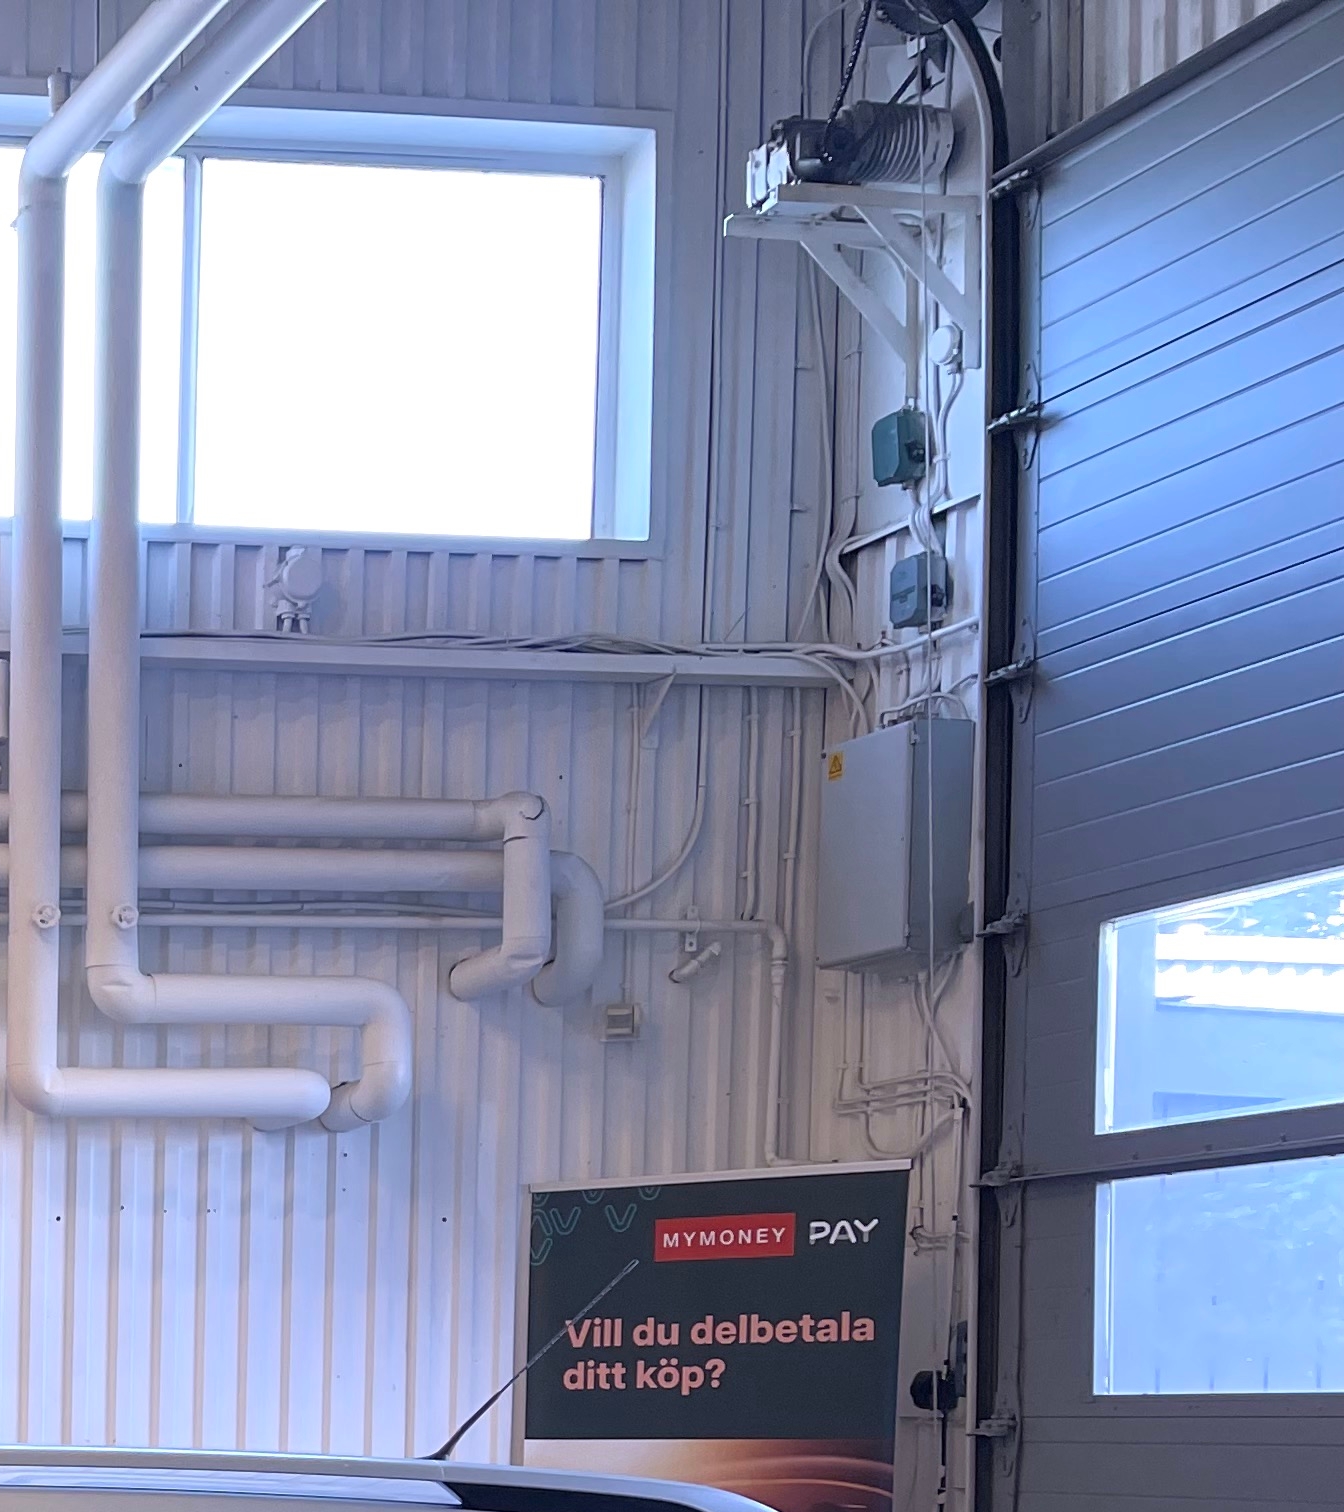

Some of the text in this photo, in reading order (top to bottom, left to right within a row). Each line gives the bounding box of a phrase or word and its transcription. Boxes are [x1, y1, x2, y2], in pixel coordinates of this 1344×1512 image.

[662, 1218, 880, 1249] MYMONEY PAY
[565, 1311, 876, 1349] Vill du delbetala
[562, 1358, 726, 1396] ditt köp?
